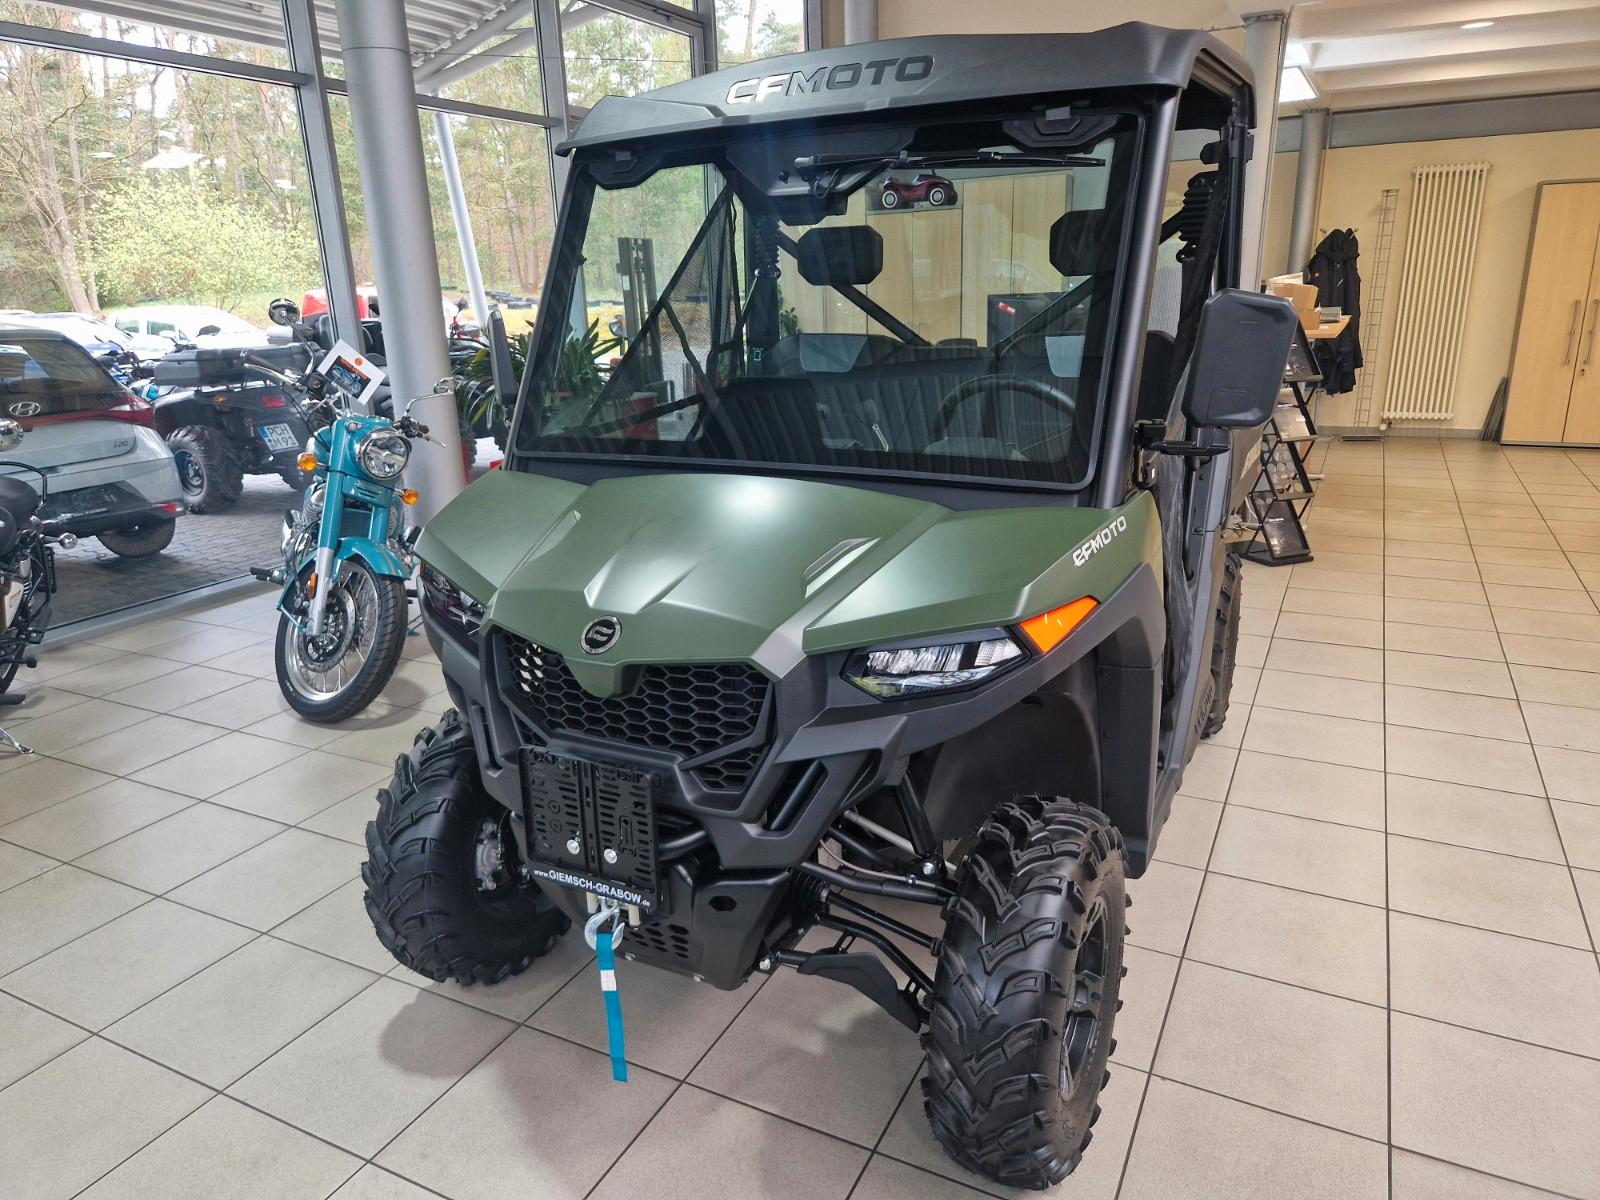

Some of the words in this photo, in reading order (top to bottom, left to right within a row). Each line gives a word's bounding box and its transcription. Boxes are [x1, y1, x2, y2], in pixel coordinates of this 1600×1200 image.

[726, 55, 934, 104] CFMOTO
[266, 424, 290, 437] PCH
[1072, 515, 1127, 567] CFMOTO
